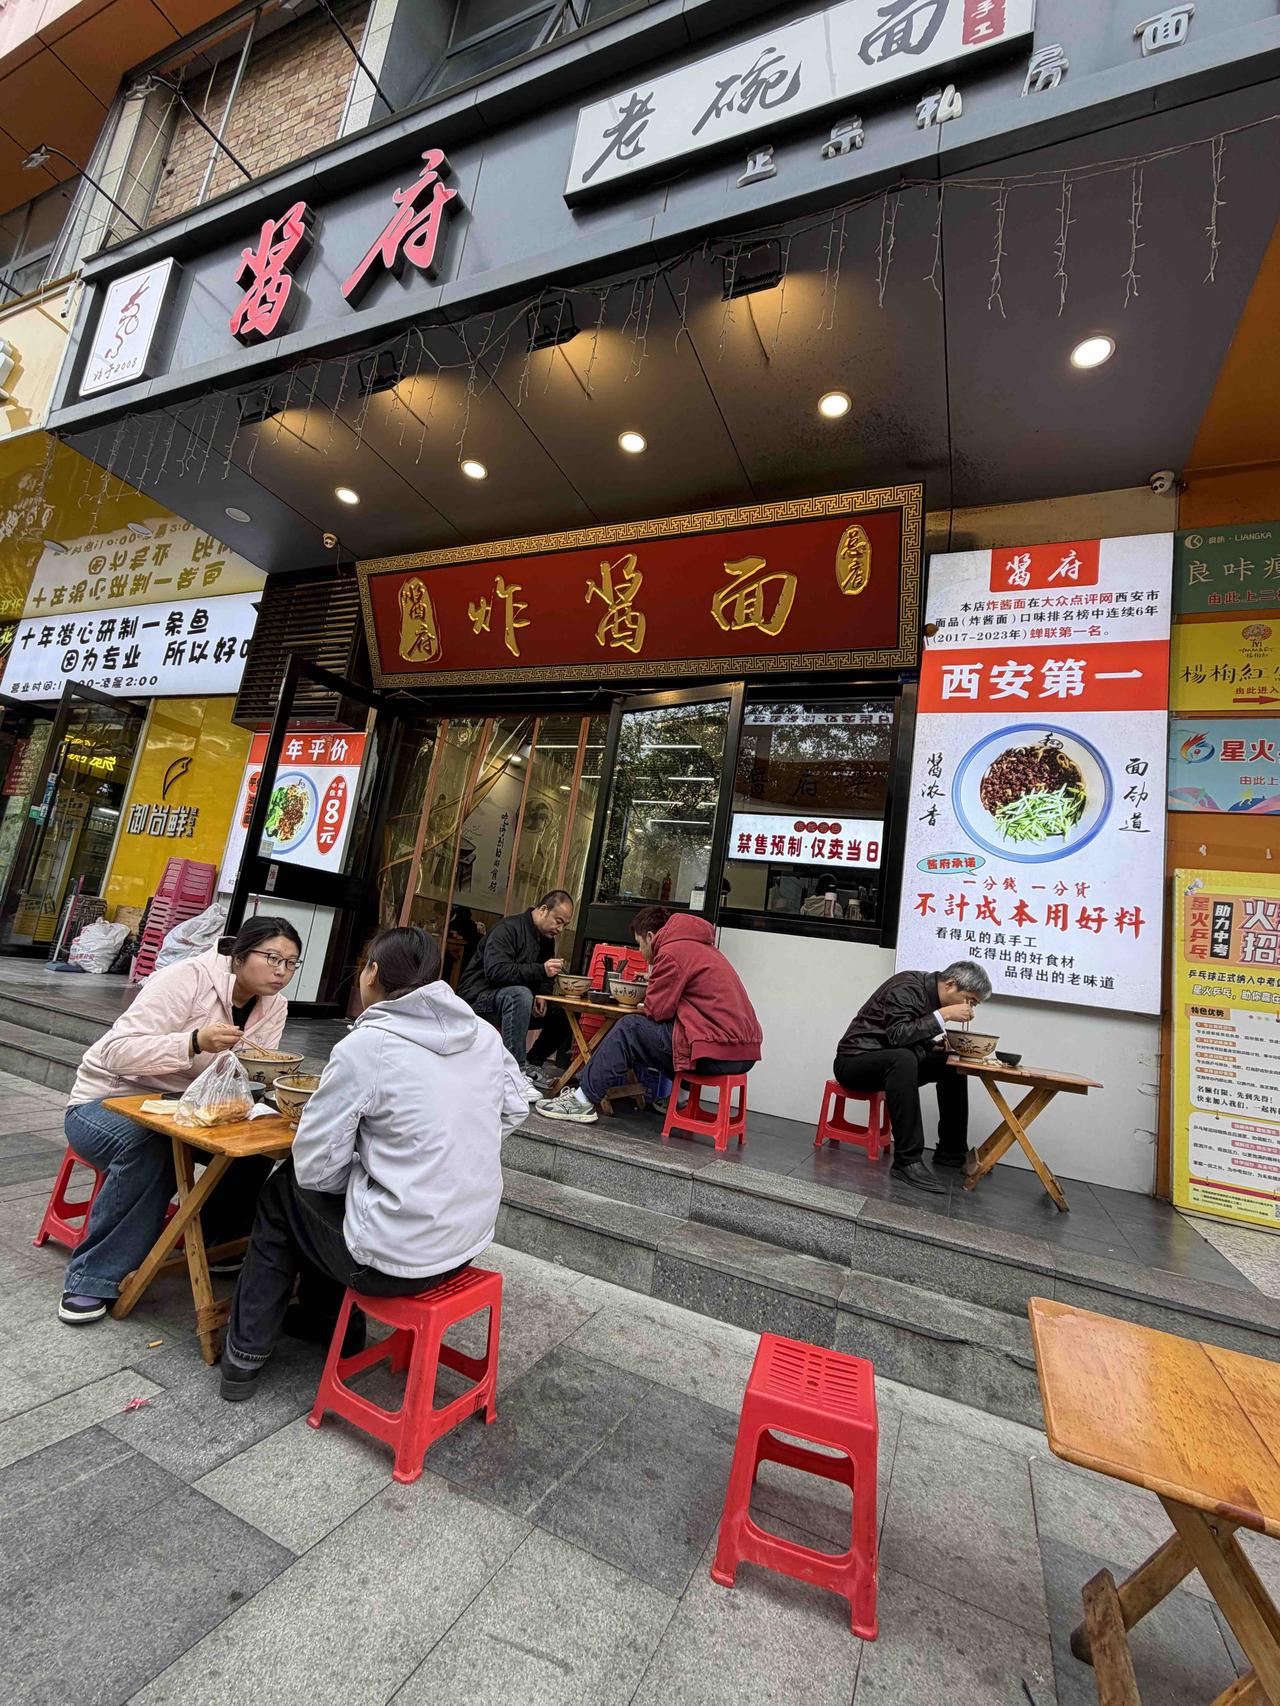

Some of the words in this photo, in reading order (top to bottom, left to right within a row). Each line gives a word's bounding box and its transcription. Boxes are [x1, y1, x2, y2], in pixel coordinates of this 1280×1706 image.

[582, 0, 950, 183] 老碗面
[1234, 531, 1273, 542] LIANGKA
[960, 589, 1160, 613] 本店炸酱面在大众点评网西安市
[20, 608, 209, 650] 十年潜心研制一条鱼
[61, 644, 141, 673] 因为专业
[941, 657, 1143, 700] 西安第一
[1235, 686, 1279, 694] 由此进入
[285, 738, 349, 761] 年平价
[1221, 739, 1280, 762] 星火
[737, 832, 880, 862] 禁售预制·仅卖当日
[1189, 896, 1210, 959] 星火乒乓
[1243, 900, 1280, 931] 火
[935, 927, 1037, 948] 看得见的真手工
[1213, 904, 1231, 957] 助力中考
[968, 946, 1075, 969] 吃得出的好食材
[1243, 932, 1280, 963] 招
[1004, 966, 1115, 990] 品得出的老味道
